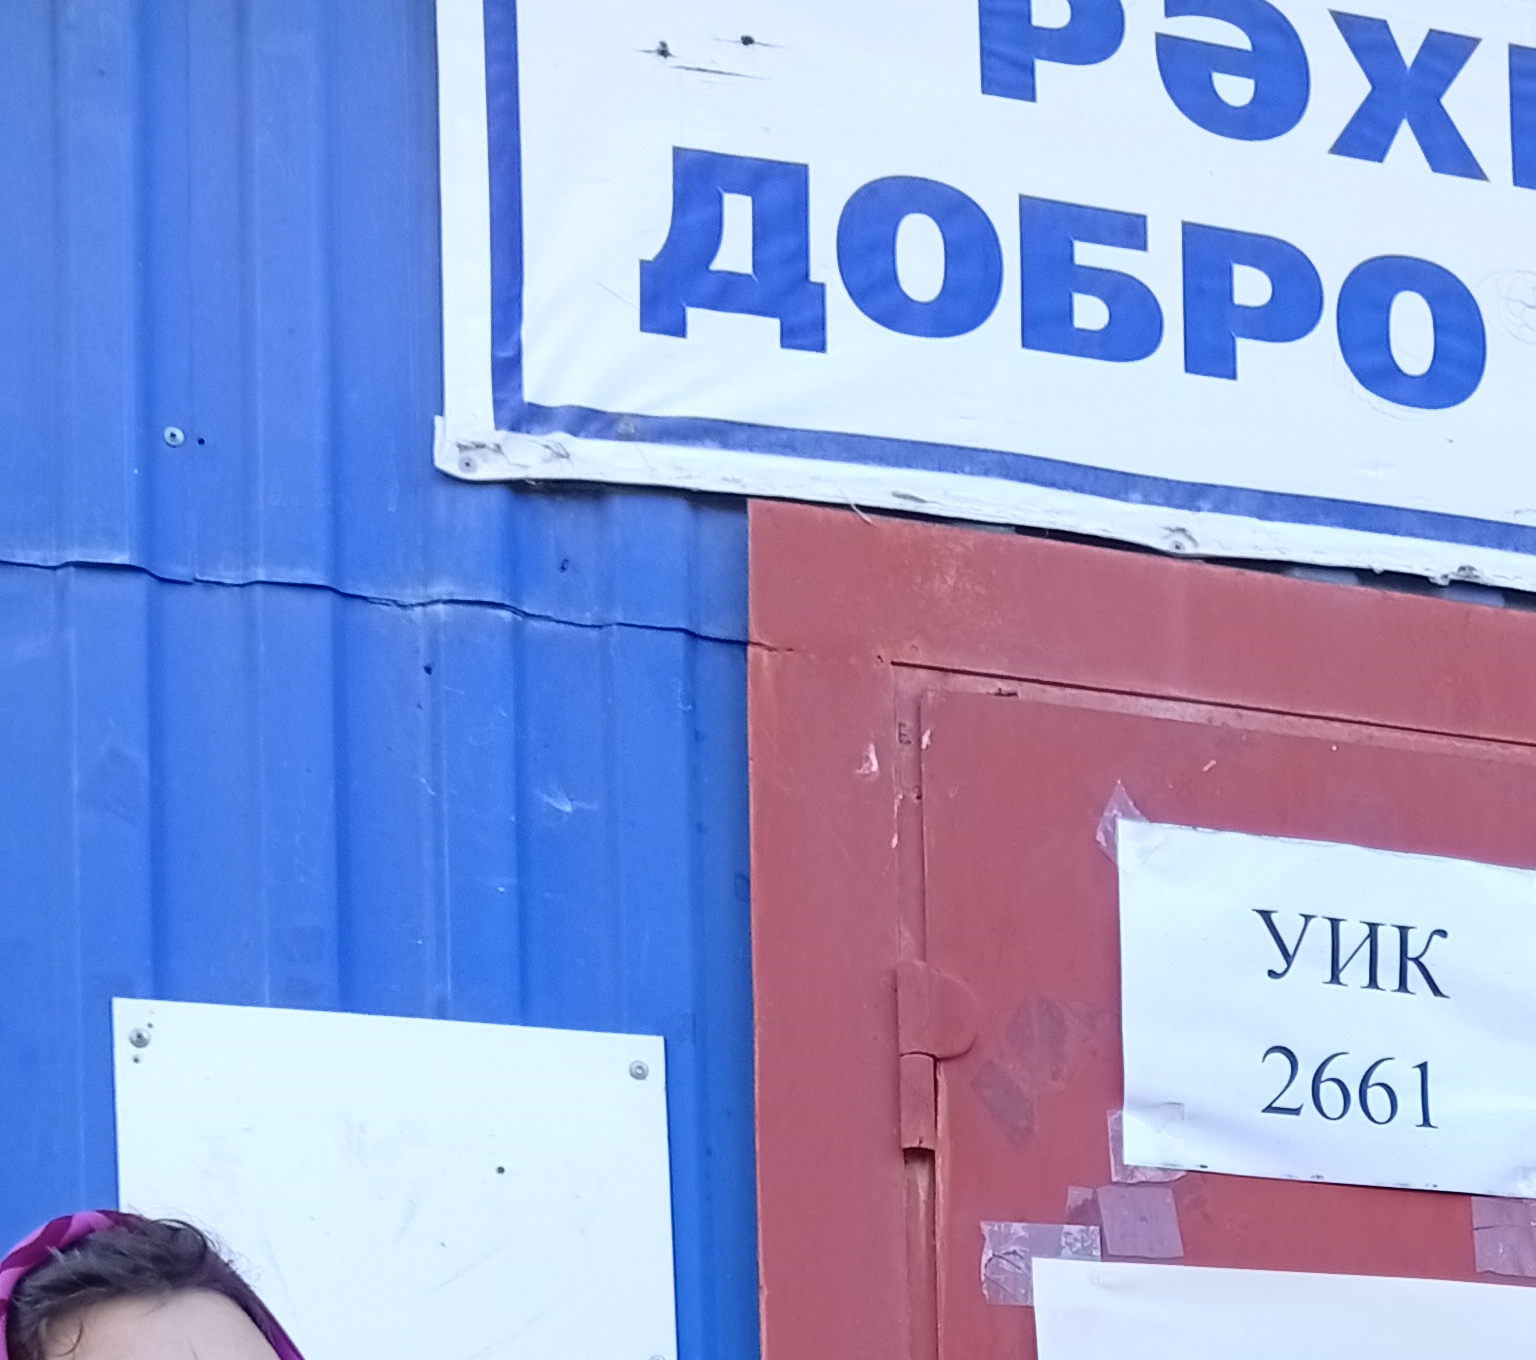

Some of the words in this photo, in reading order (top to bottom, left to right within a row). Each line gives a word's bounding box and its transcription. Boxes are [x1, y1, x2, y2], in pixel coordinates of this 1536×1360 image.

[639, 146, 1487, 411] ДОБРО
[1252, 908, 1451, 999] УИК
[1261, 1045, 1438, 1129] 2661
